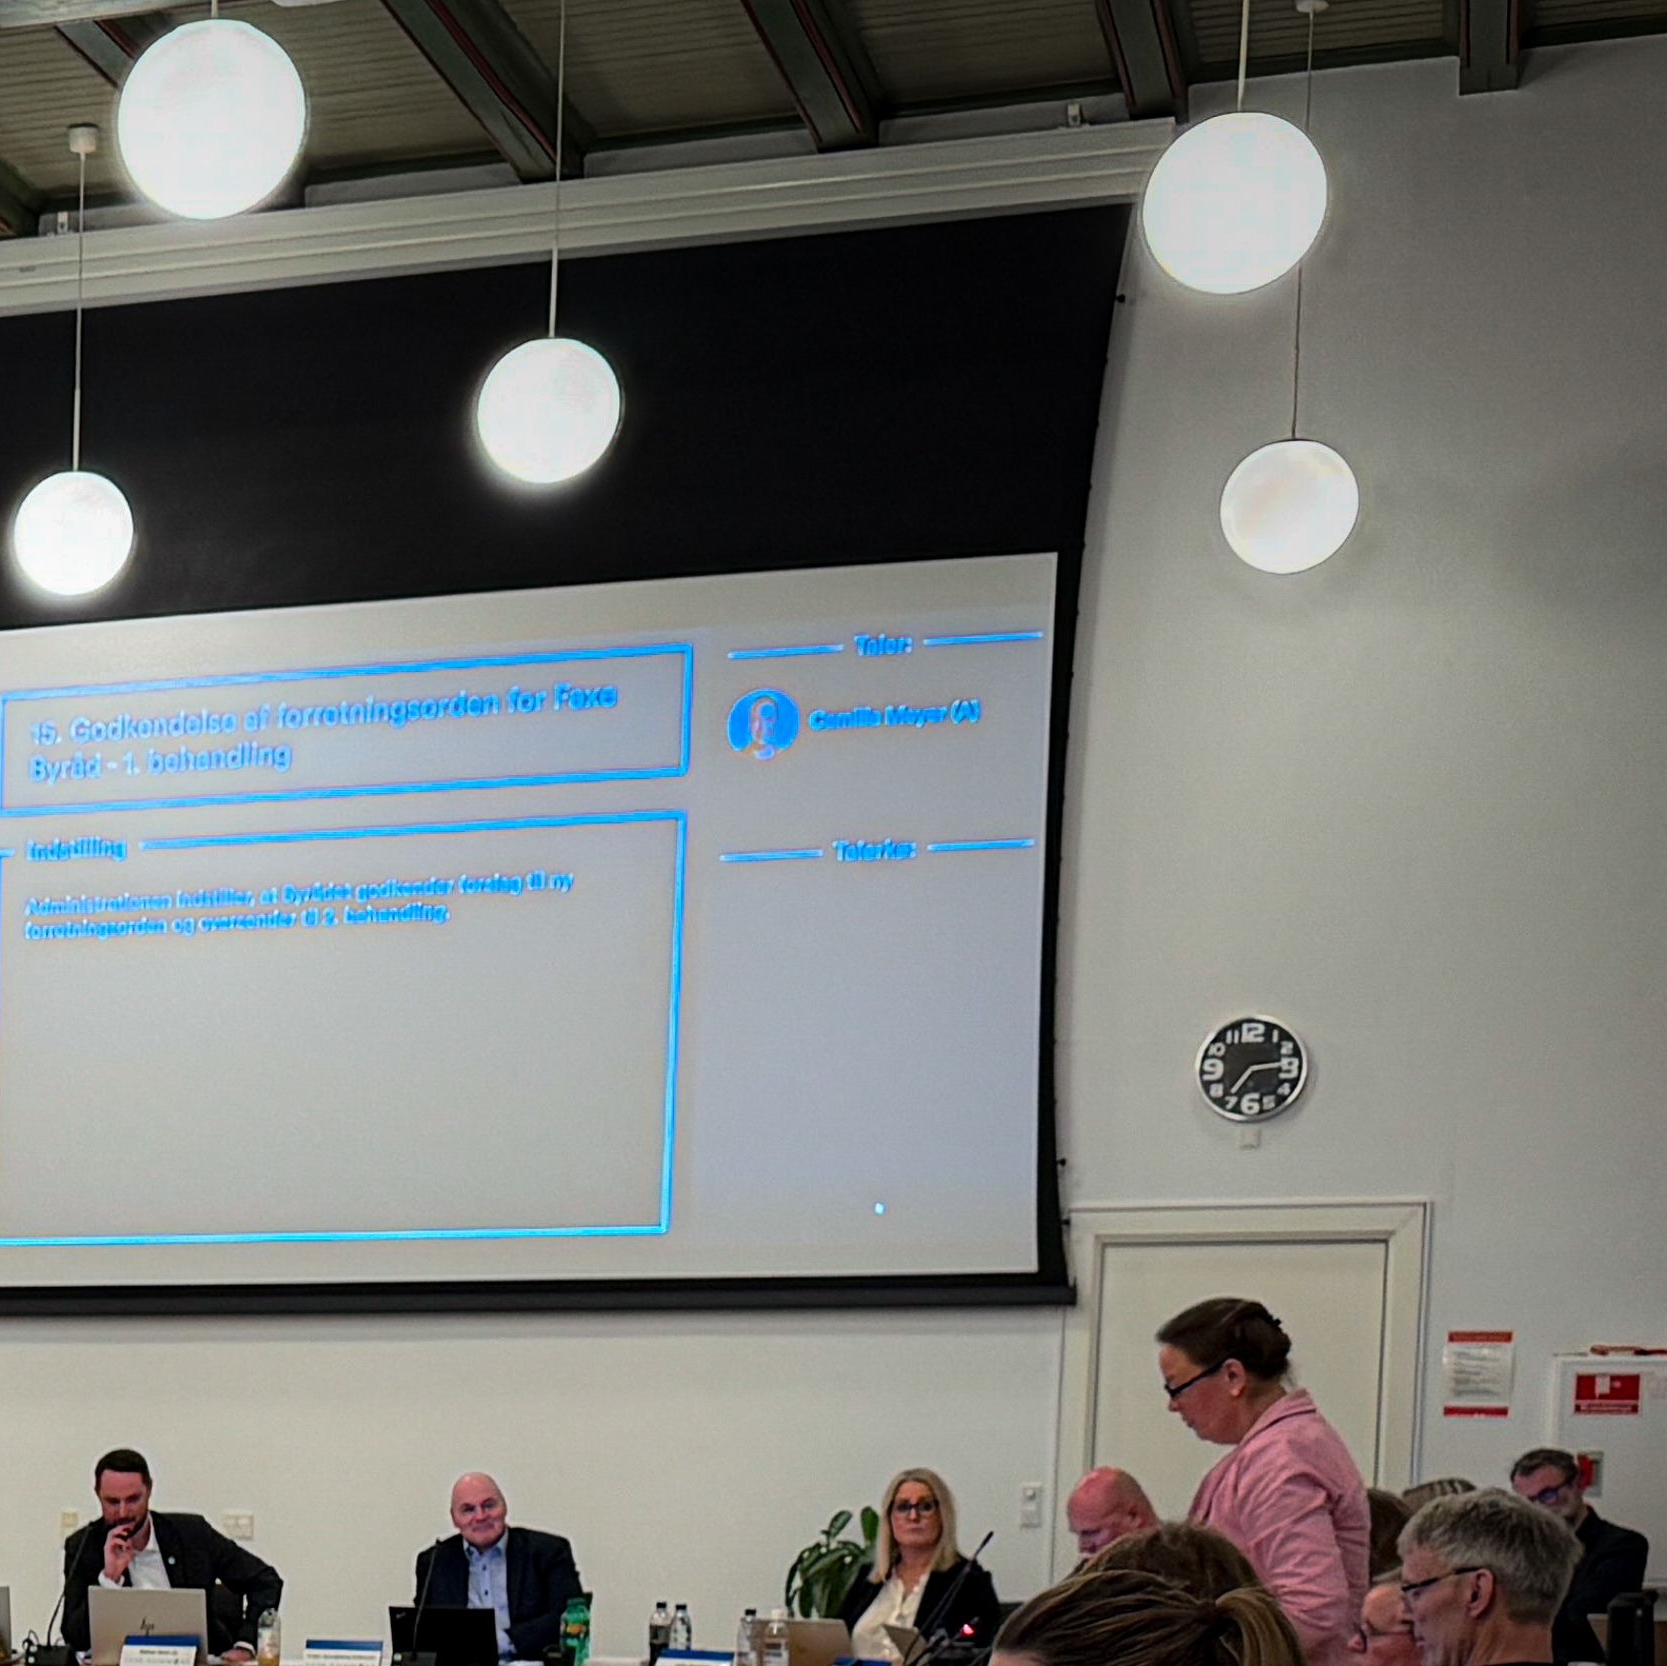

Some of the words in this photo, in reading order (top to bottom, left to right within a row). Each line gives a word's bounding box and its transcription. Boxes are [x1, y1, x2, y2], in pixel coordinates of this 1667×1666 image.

[29, 721, 62, 746] 15.
[69, 708, 237, 745] Godkendelse
[243, 704, 271, 732] af
[276, 688, 500, 729] forretningsorden
[506, 684, 547, 714] for
[552, 681, 619, 711] Faxe
[29, 751, 102, 788] Byråd
[122, 751, 141, 776] 1.
[147, 740, 294, 774] behandling
[26, 835, 128, 863] Indstilling
[171, 917, 196, 937] og
[1226, 1029, 1239, 1044] 11
[1241, 1022, 1265, 1043] 12
[1272, 1029, 1279, 1044] 1
[1207, 1042, 1225, 1057] 10
[1280, 1041, 1293, 1055] 2
[1202, 1058, 1224, 1081] 9
[1209, 1083, 1223, 1097] 8
[1277, 1083, 1291, 1096] 4
[1224, 1096, 1238, 1109] 7
[1240, 1093, 1260, 1115] 6
[1262, 1095, 1276, 1110] 5
